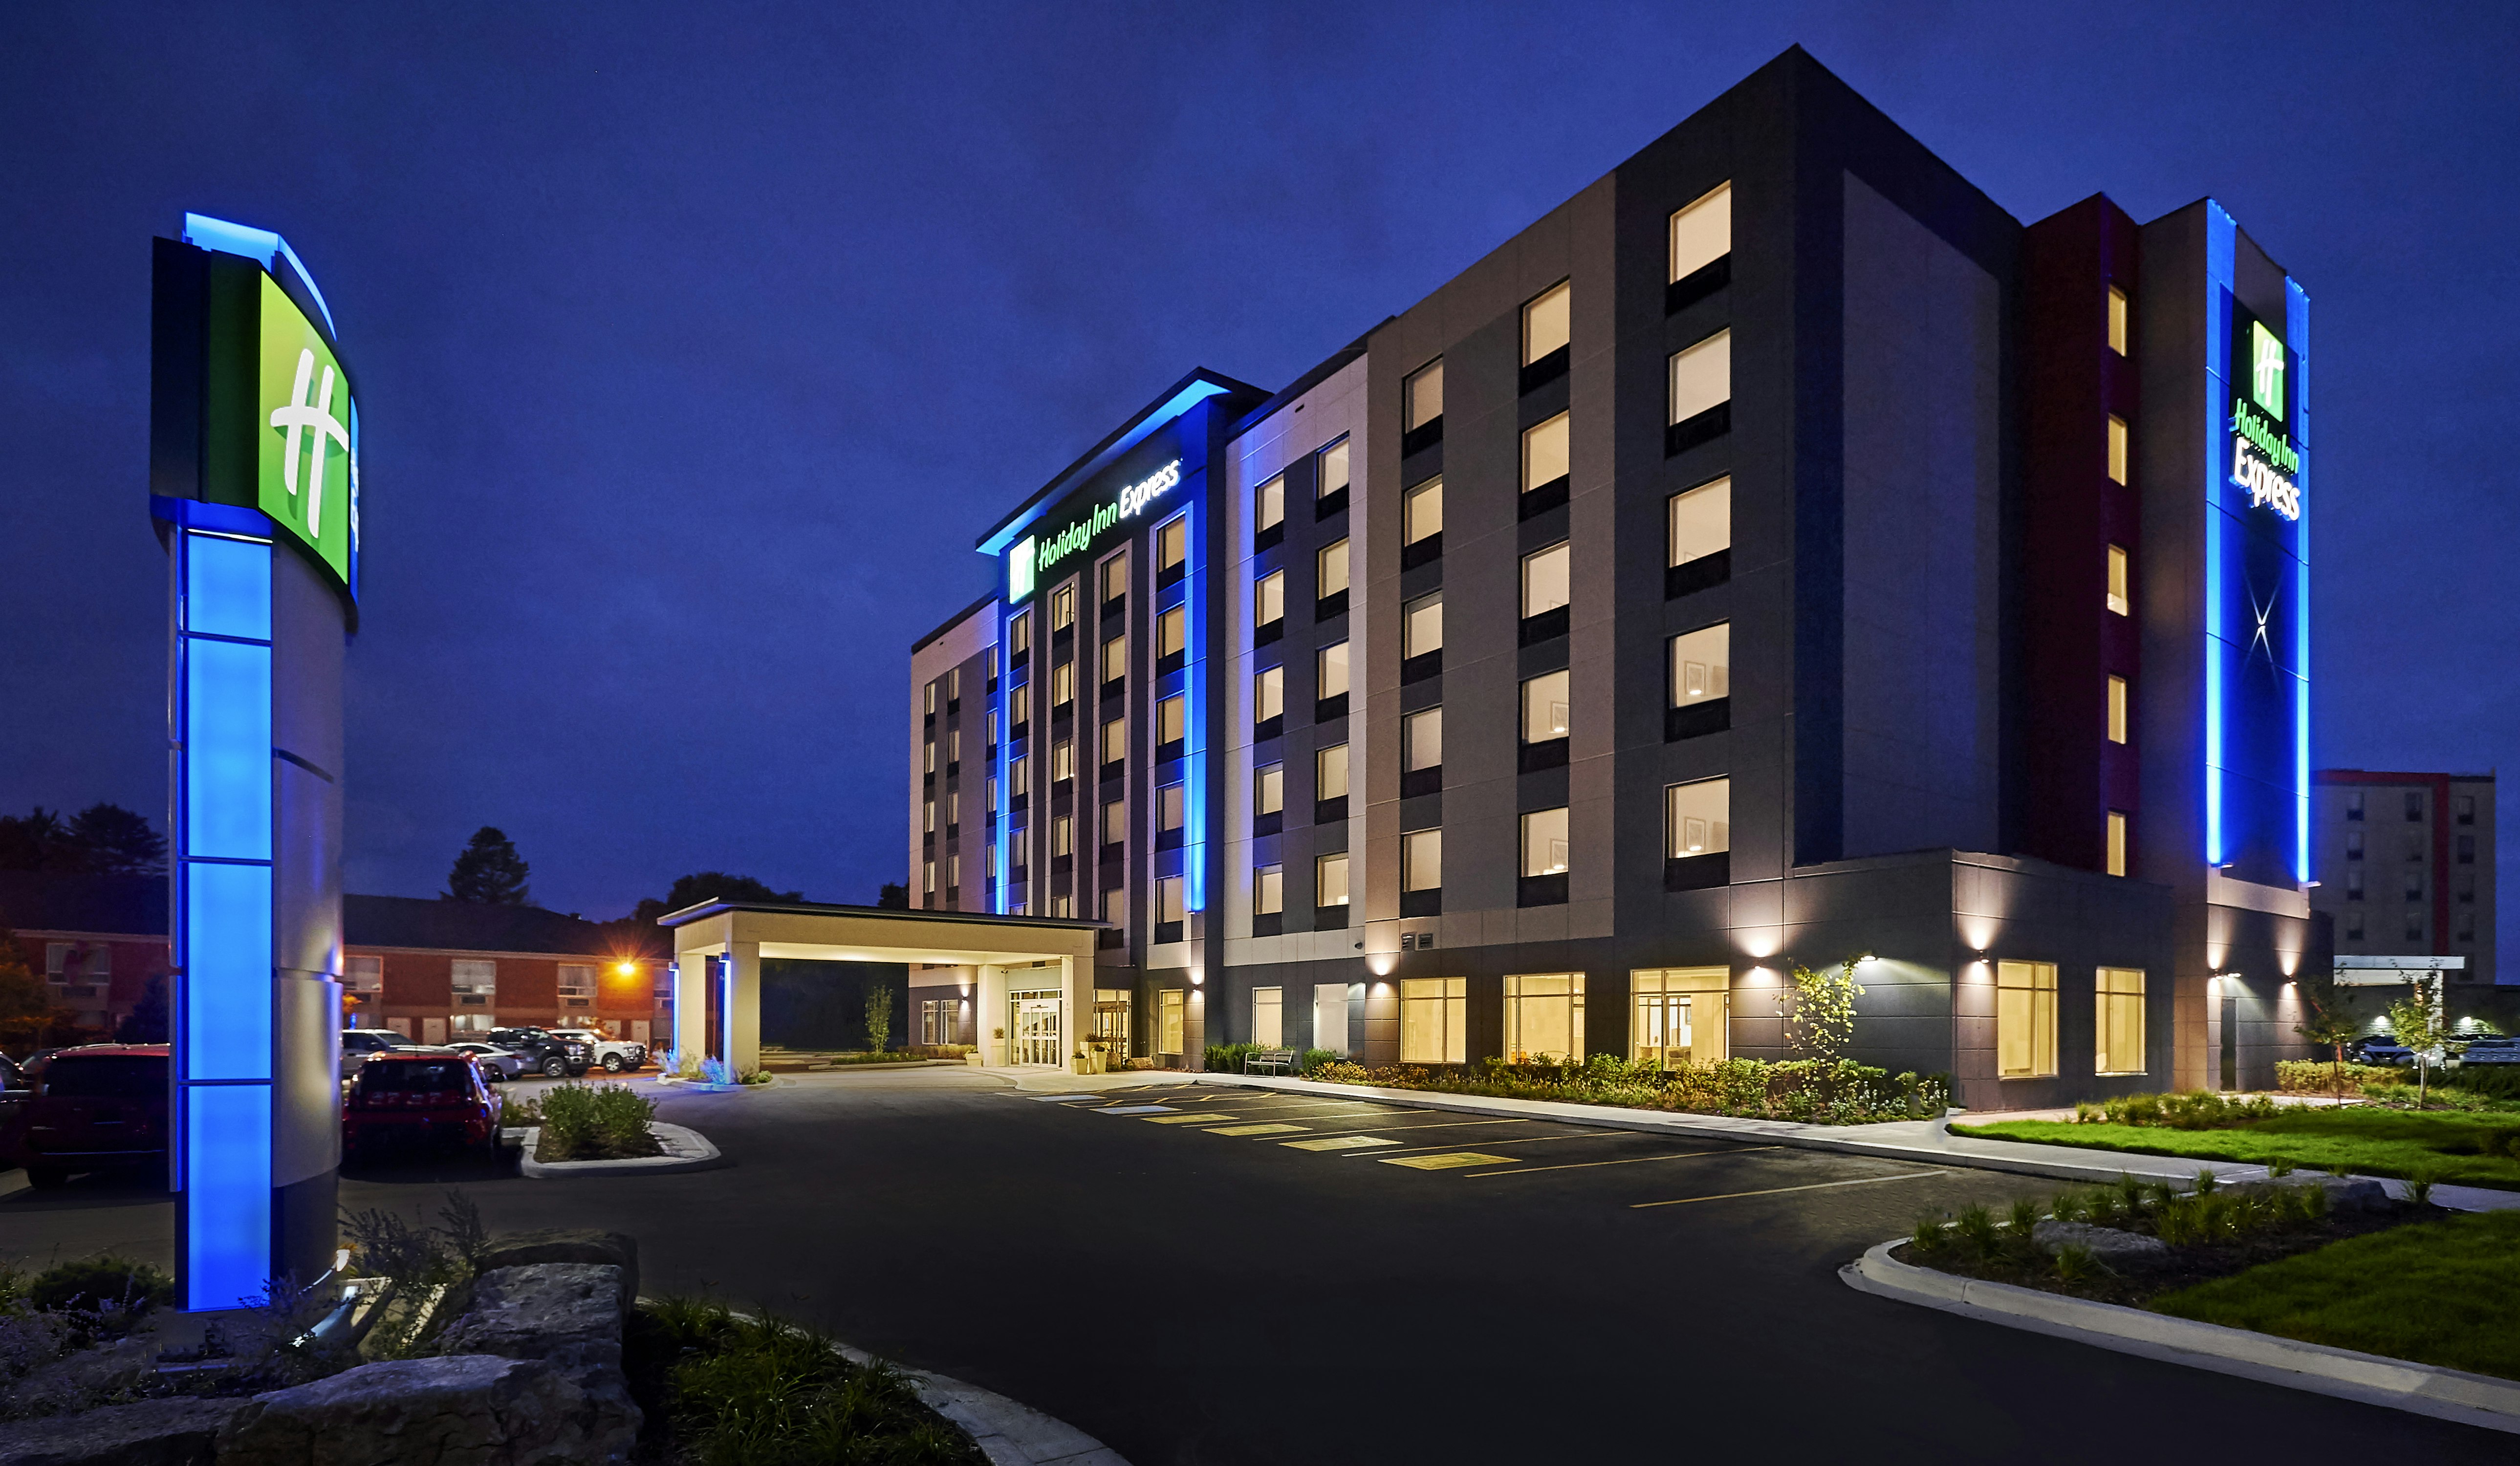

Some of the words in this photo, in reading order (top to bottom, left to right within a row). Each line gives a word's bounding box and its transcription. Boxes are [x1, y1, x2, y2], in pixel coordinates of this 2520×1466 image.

[2256, 339, 2284, 407] H
[270, 348, 348, 539] H
[2235, 397, 2281, 467] Holiday
[2281, 433, 2299, 474] Inn
[1038, 518, 1092, 572] Holiday
[1092, 503, 1117, 536] Inn
[1119, 459, 1179, 519] Express
[2234, 436, 2301, 521] Express
